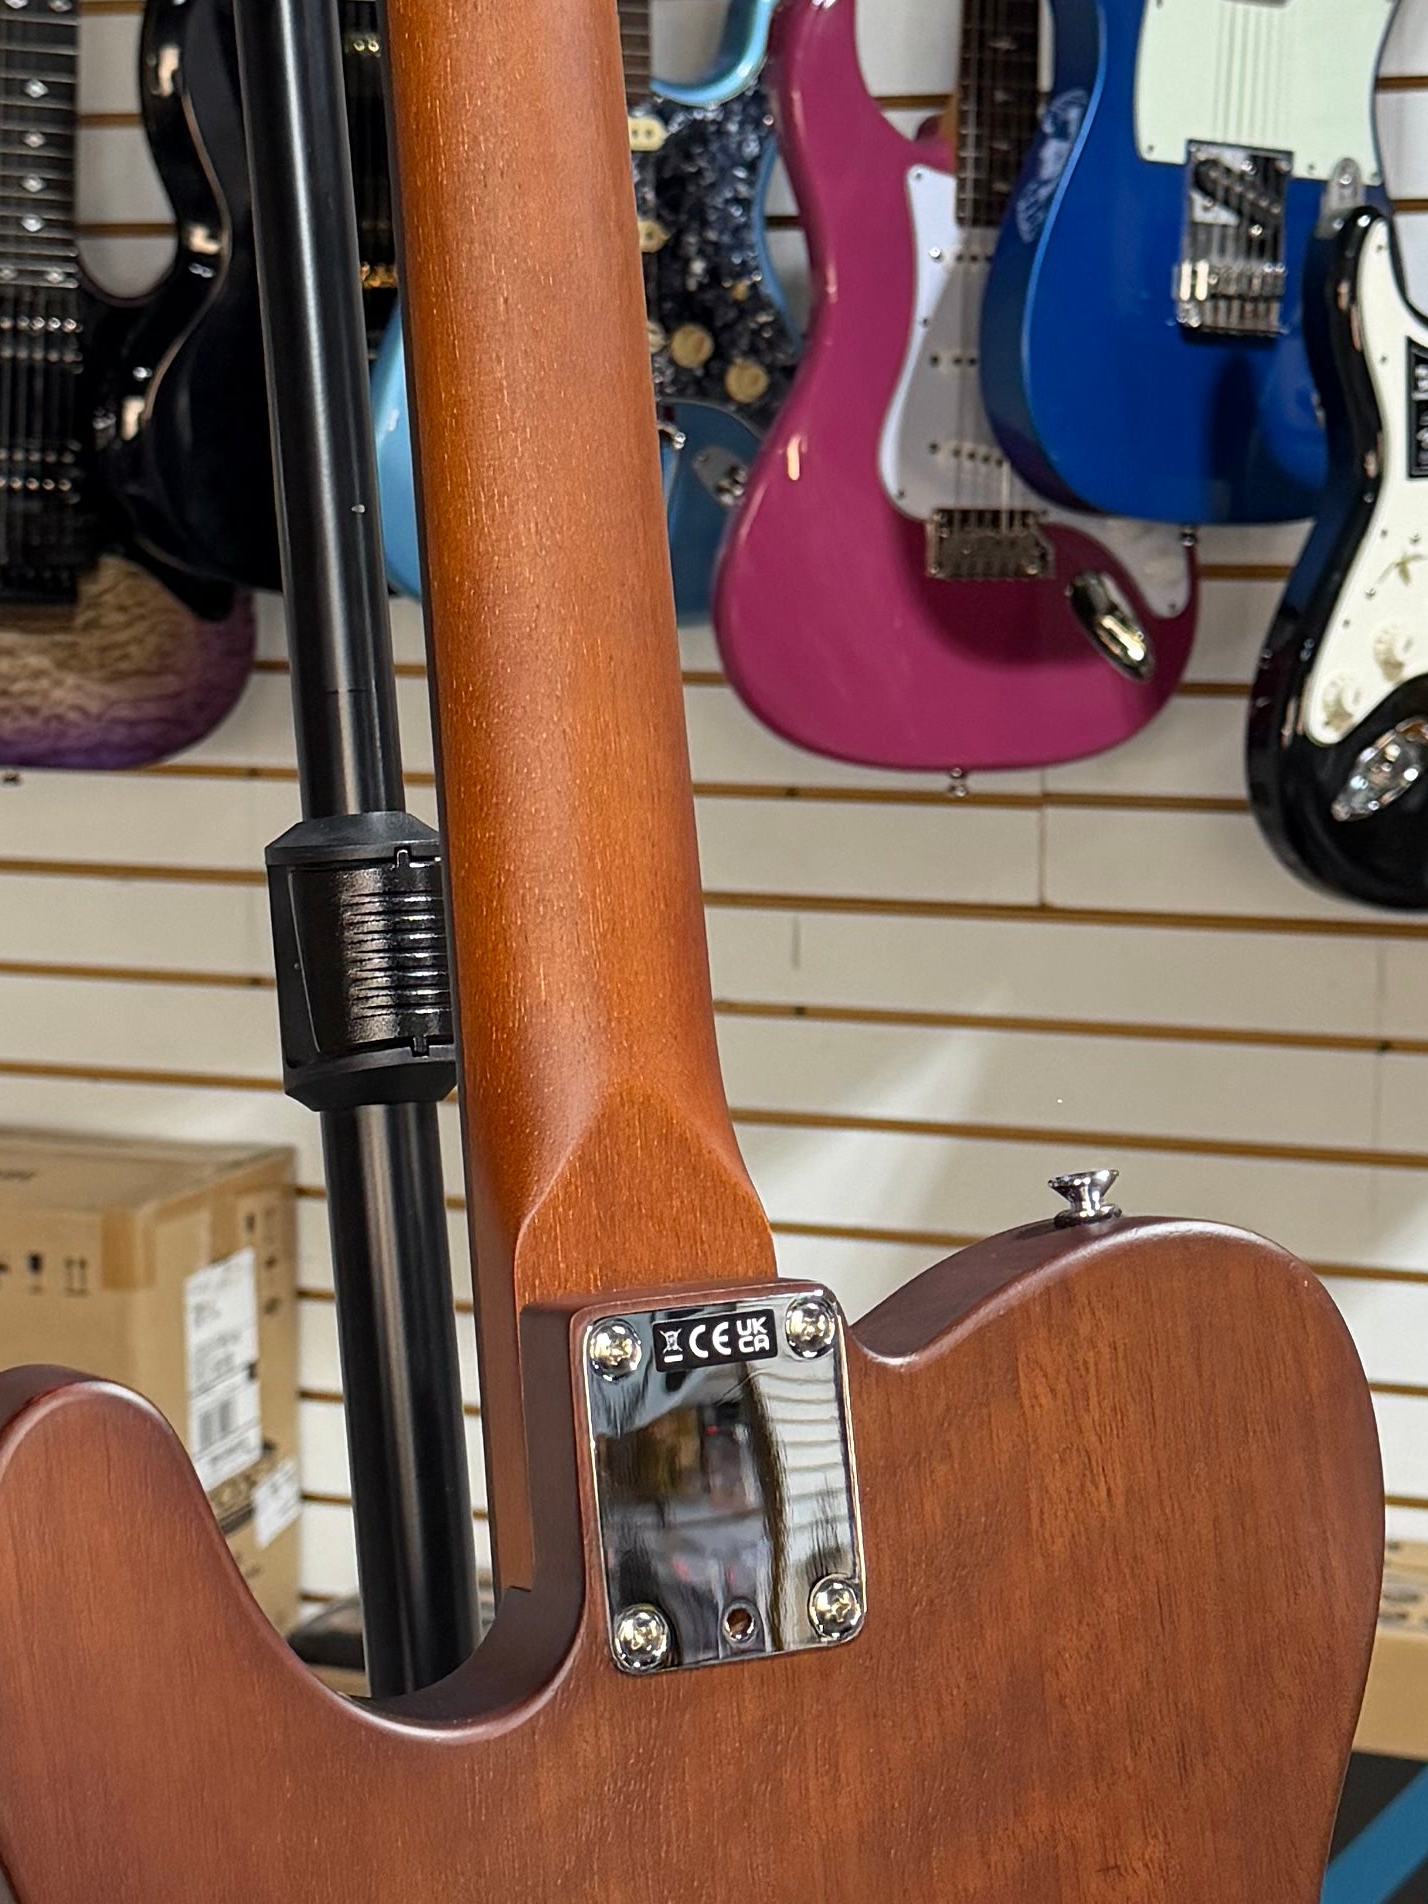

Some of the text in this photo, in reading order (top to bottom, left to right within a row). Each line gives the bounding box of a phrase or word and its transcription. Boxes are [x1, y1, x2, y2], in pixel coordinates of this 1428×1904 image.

[736, 1316, 769, 1336] UK
[688, 1320, 733, 1360] CE
[738, 1335, 771, 1354] CA
